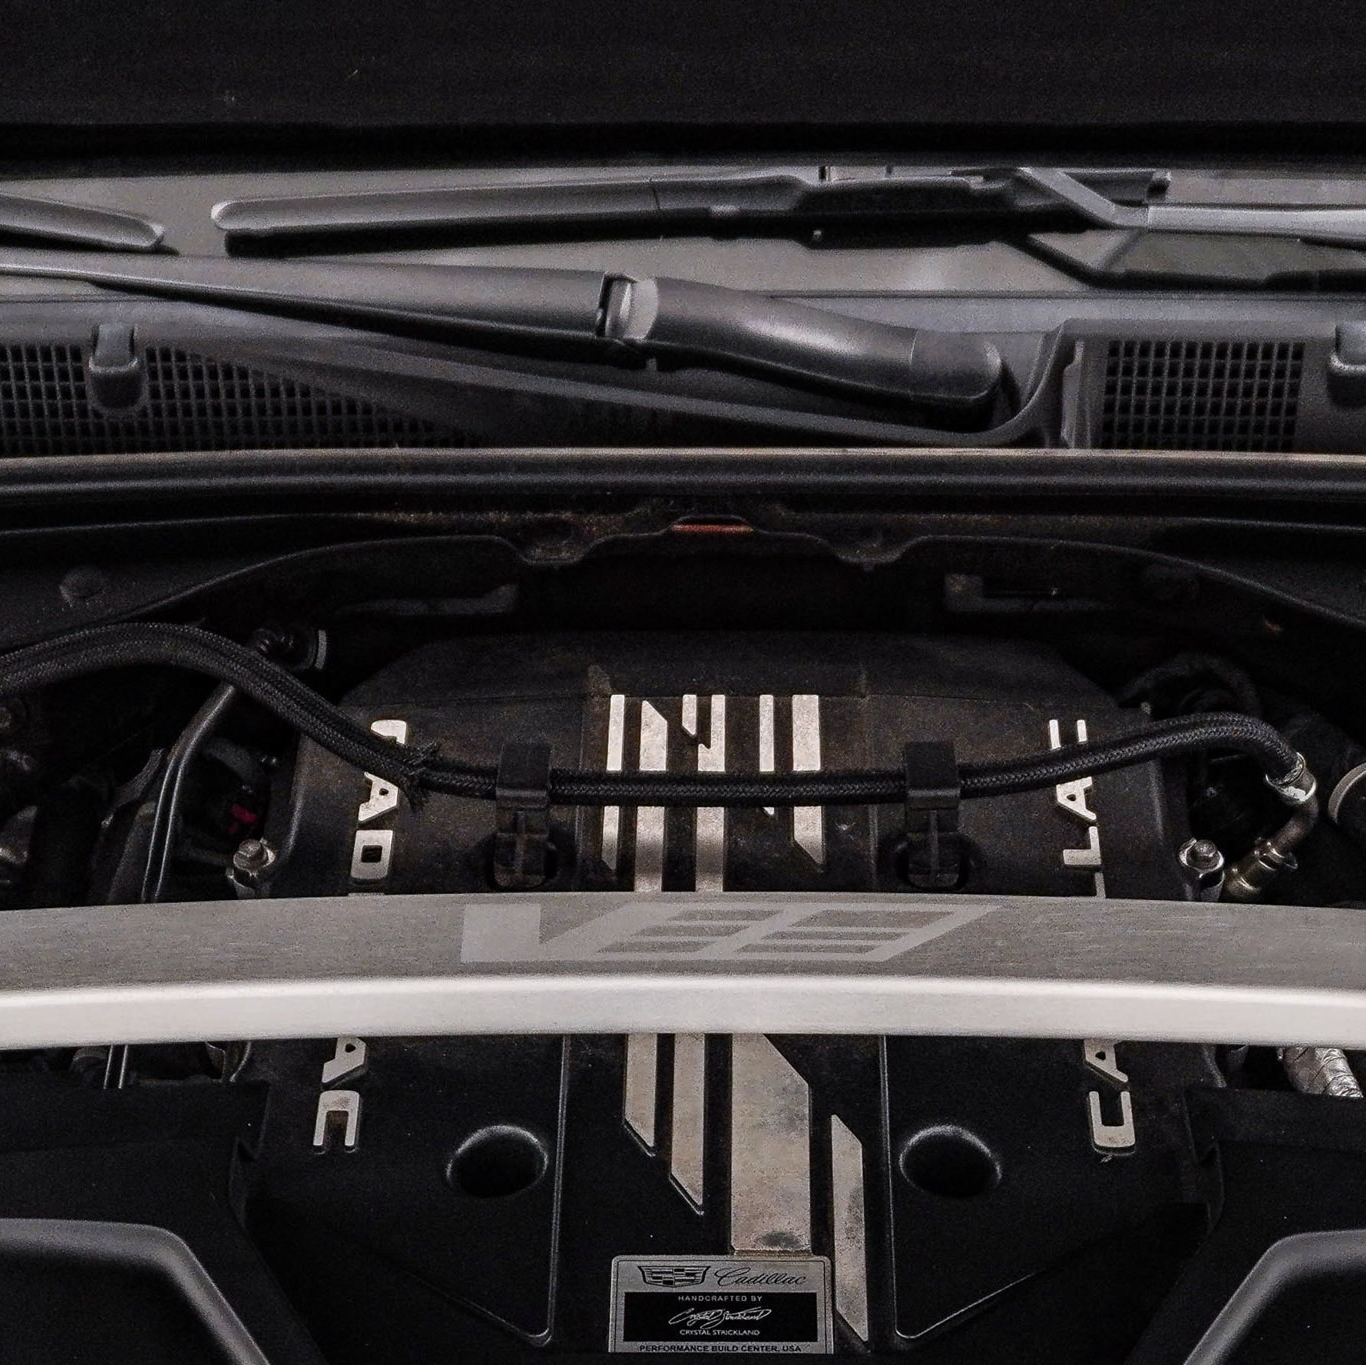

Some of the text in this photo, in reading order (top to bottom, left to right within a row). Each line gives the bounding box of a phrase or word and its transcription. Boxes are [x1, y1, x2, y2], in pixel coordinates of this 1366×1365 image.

[714, 1267, 806, 1287] Cadillac
[639, 1344, 710, 1352] PERFORMANCE
[712, 1344, 739, 1352] BUILD
[782, 1344, 801, 1352] USA
